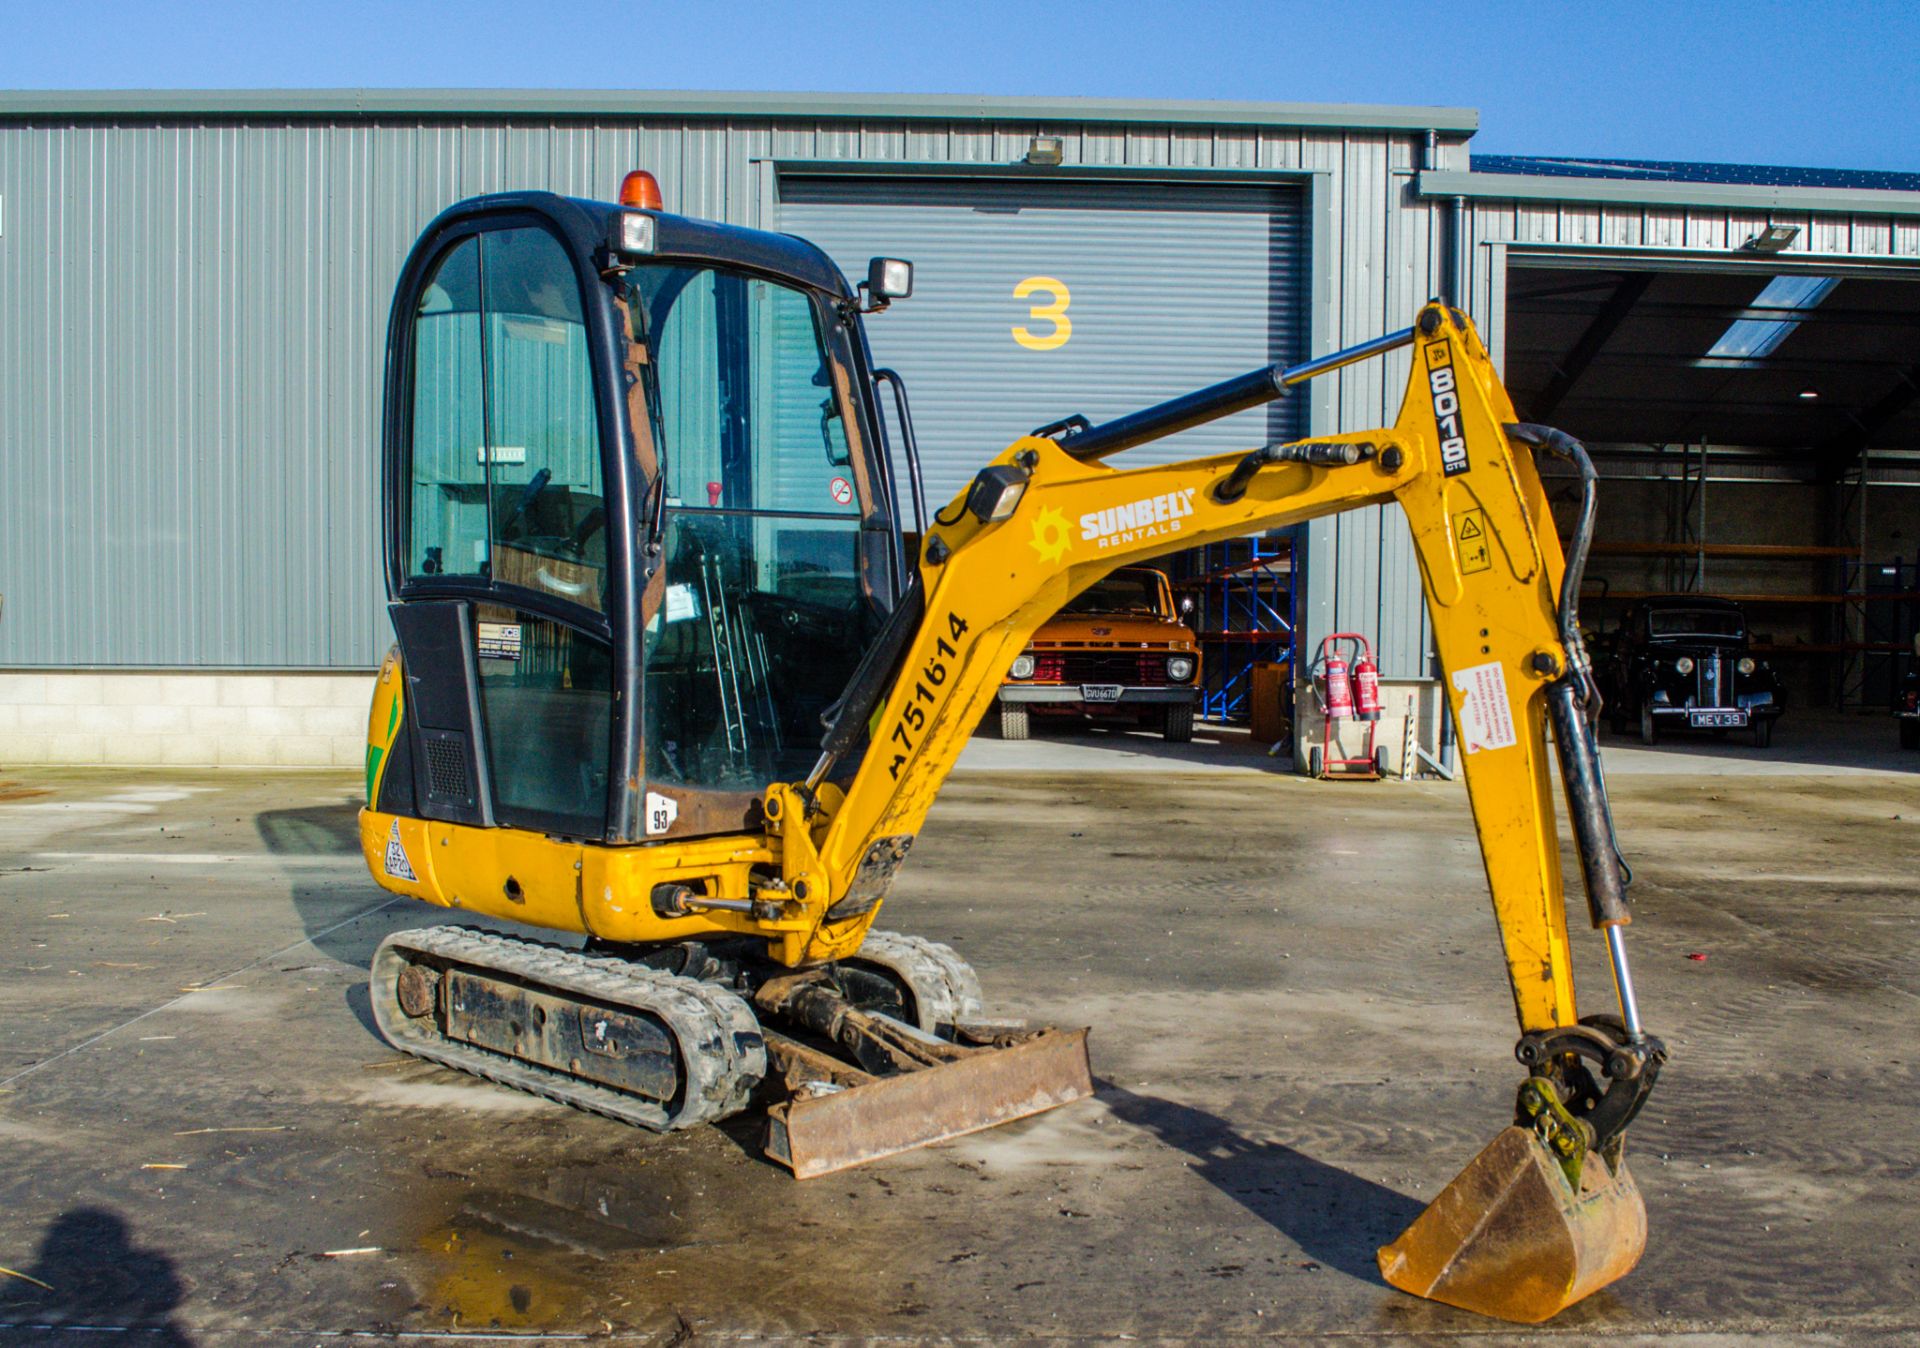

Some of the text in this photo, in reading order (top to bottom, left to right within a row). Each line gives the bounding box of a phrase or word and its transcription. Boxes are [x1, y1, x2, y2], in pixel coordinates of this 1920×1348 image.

[1011, 275, 1072, 351] 3
[1430, 367, 1466, 463] 8018
[1080, 488, 1195, 540] SUNBELT
[1098, 520, 1182, 548] RENTALS
[500, 628, 520, 638] JCB
[1698, 714, 1740, 725] MEV 39
[654, 810, 668, 830] 93
